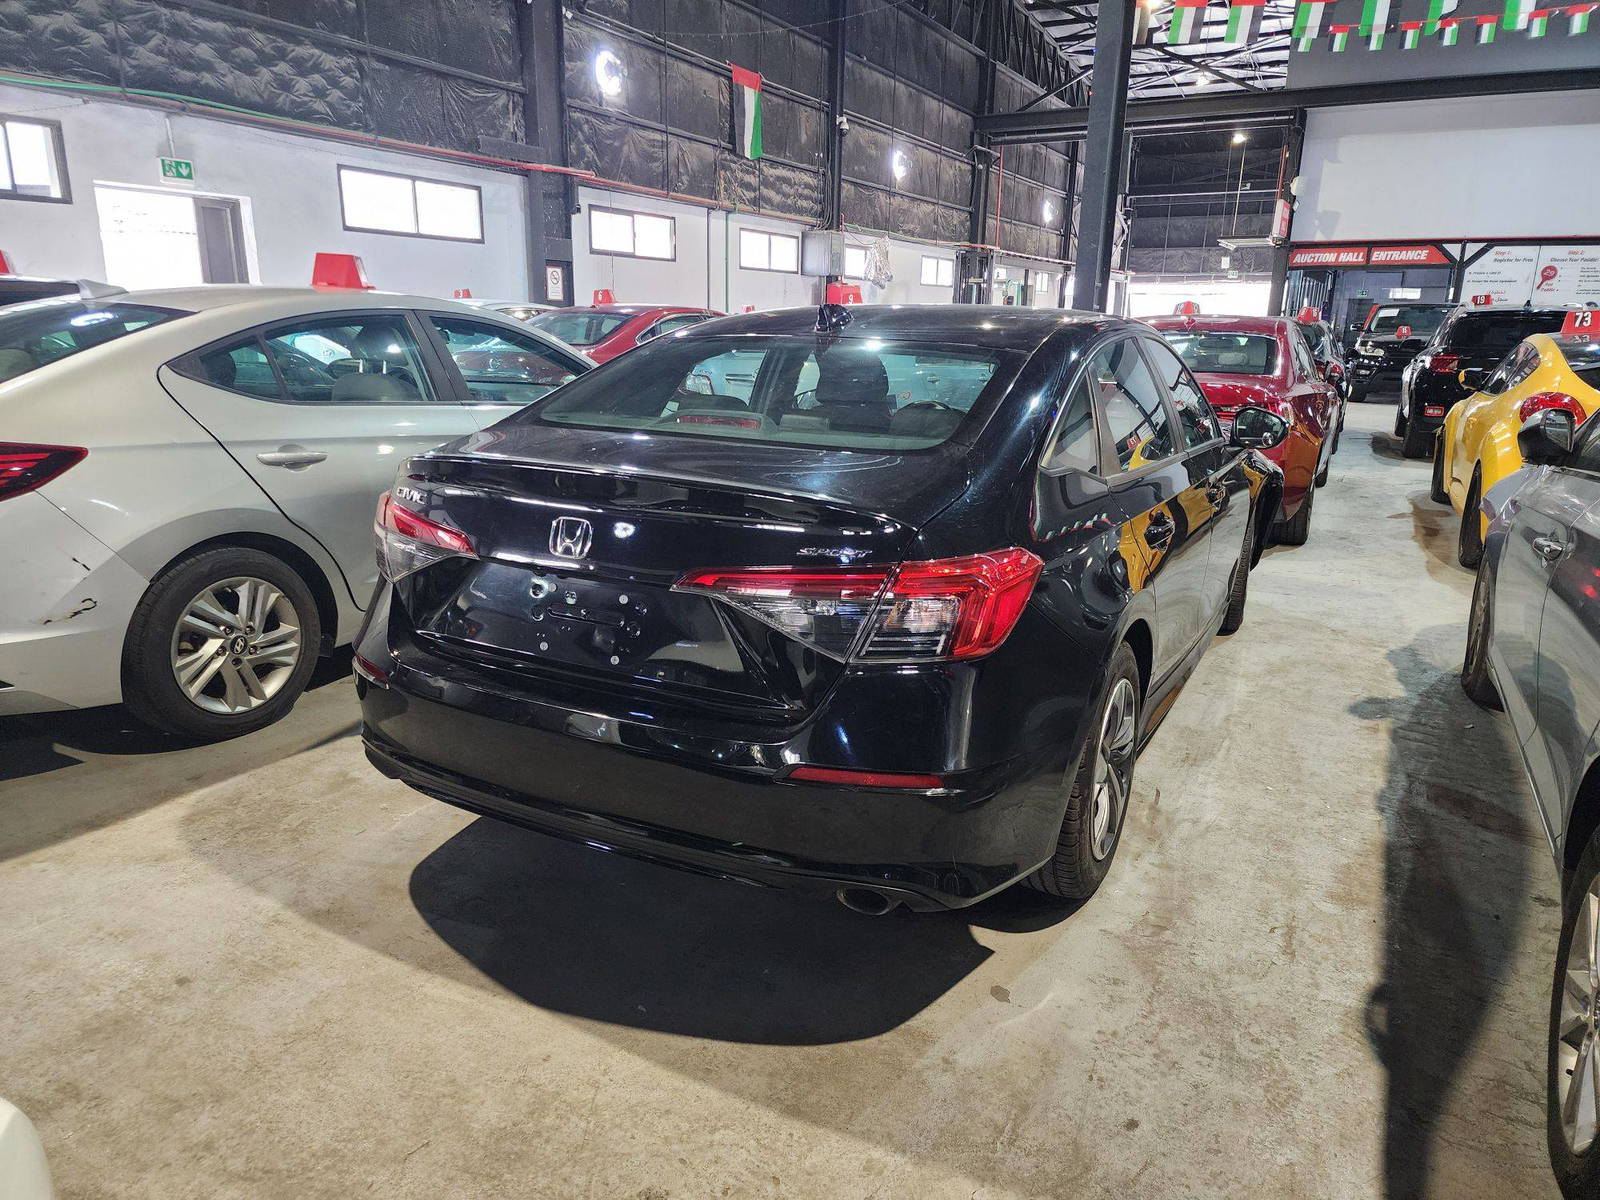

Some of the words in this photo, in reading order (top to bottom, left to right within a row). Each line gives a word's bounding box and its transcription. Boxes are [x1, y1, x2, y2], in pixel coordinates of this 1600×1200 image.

[1293, 252, 1336, 263] AUCTION
[1338, 251, 1364, 262] HALL
[1371, 250, 1429, 261] ENTRANCE
[1476, 295, 1485, 304] 19
[1574, 311, 1592, 328] 73
[396, 486, 427, 505] CIVIC
[796, 547, 873, 558] SPORT
